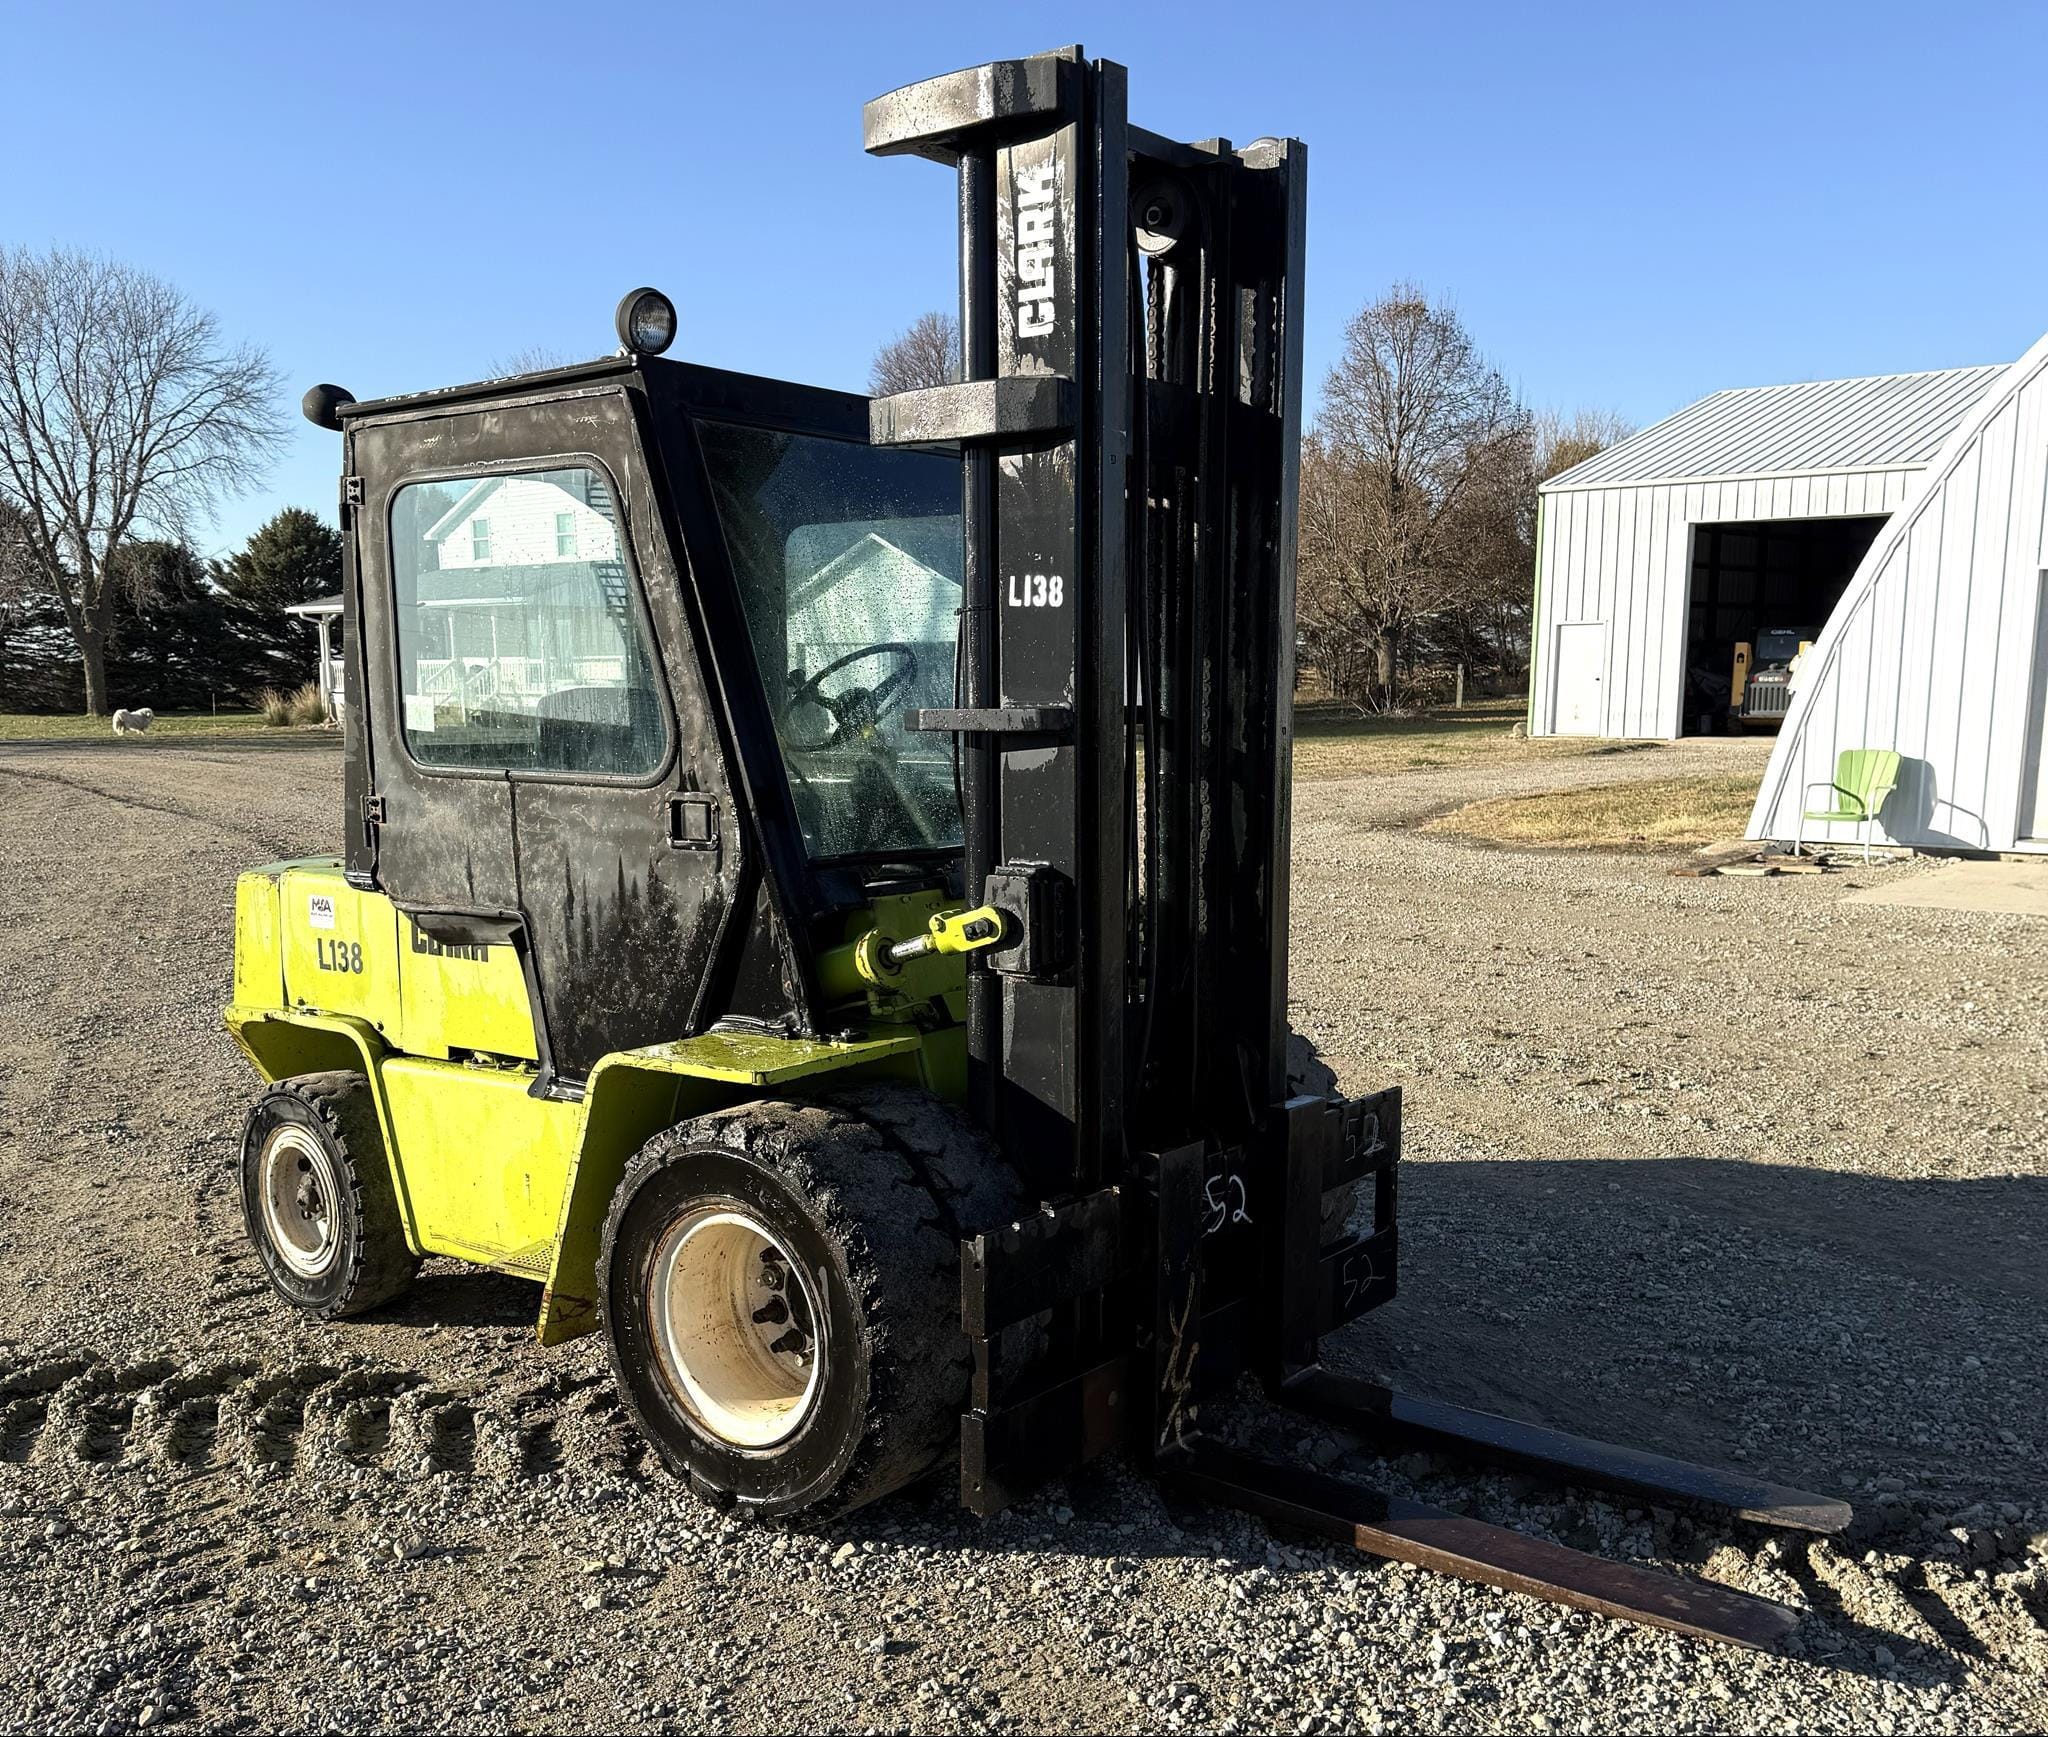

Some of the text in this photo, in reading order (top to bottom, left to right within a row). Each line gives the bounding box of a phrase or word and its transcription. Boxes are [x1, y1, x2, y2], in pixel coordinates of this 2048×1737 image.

[1018, 165, 1055, 338] CLARK
[1009, 574, 1063, 607] L138
[317, 937, 364, 975] L138
[1345, 1112, 1386, 1162] 52
[1205, 1174, 1253, 1233] 52
[1343, 1254, 1386, 1309] 52
